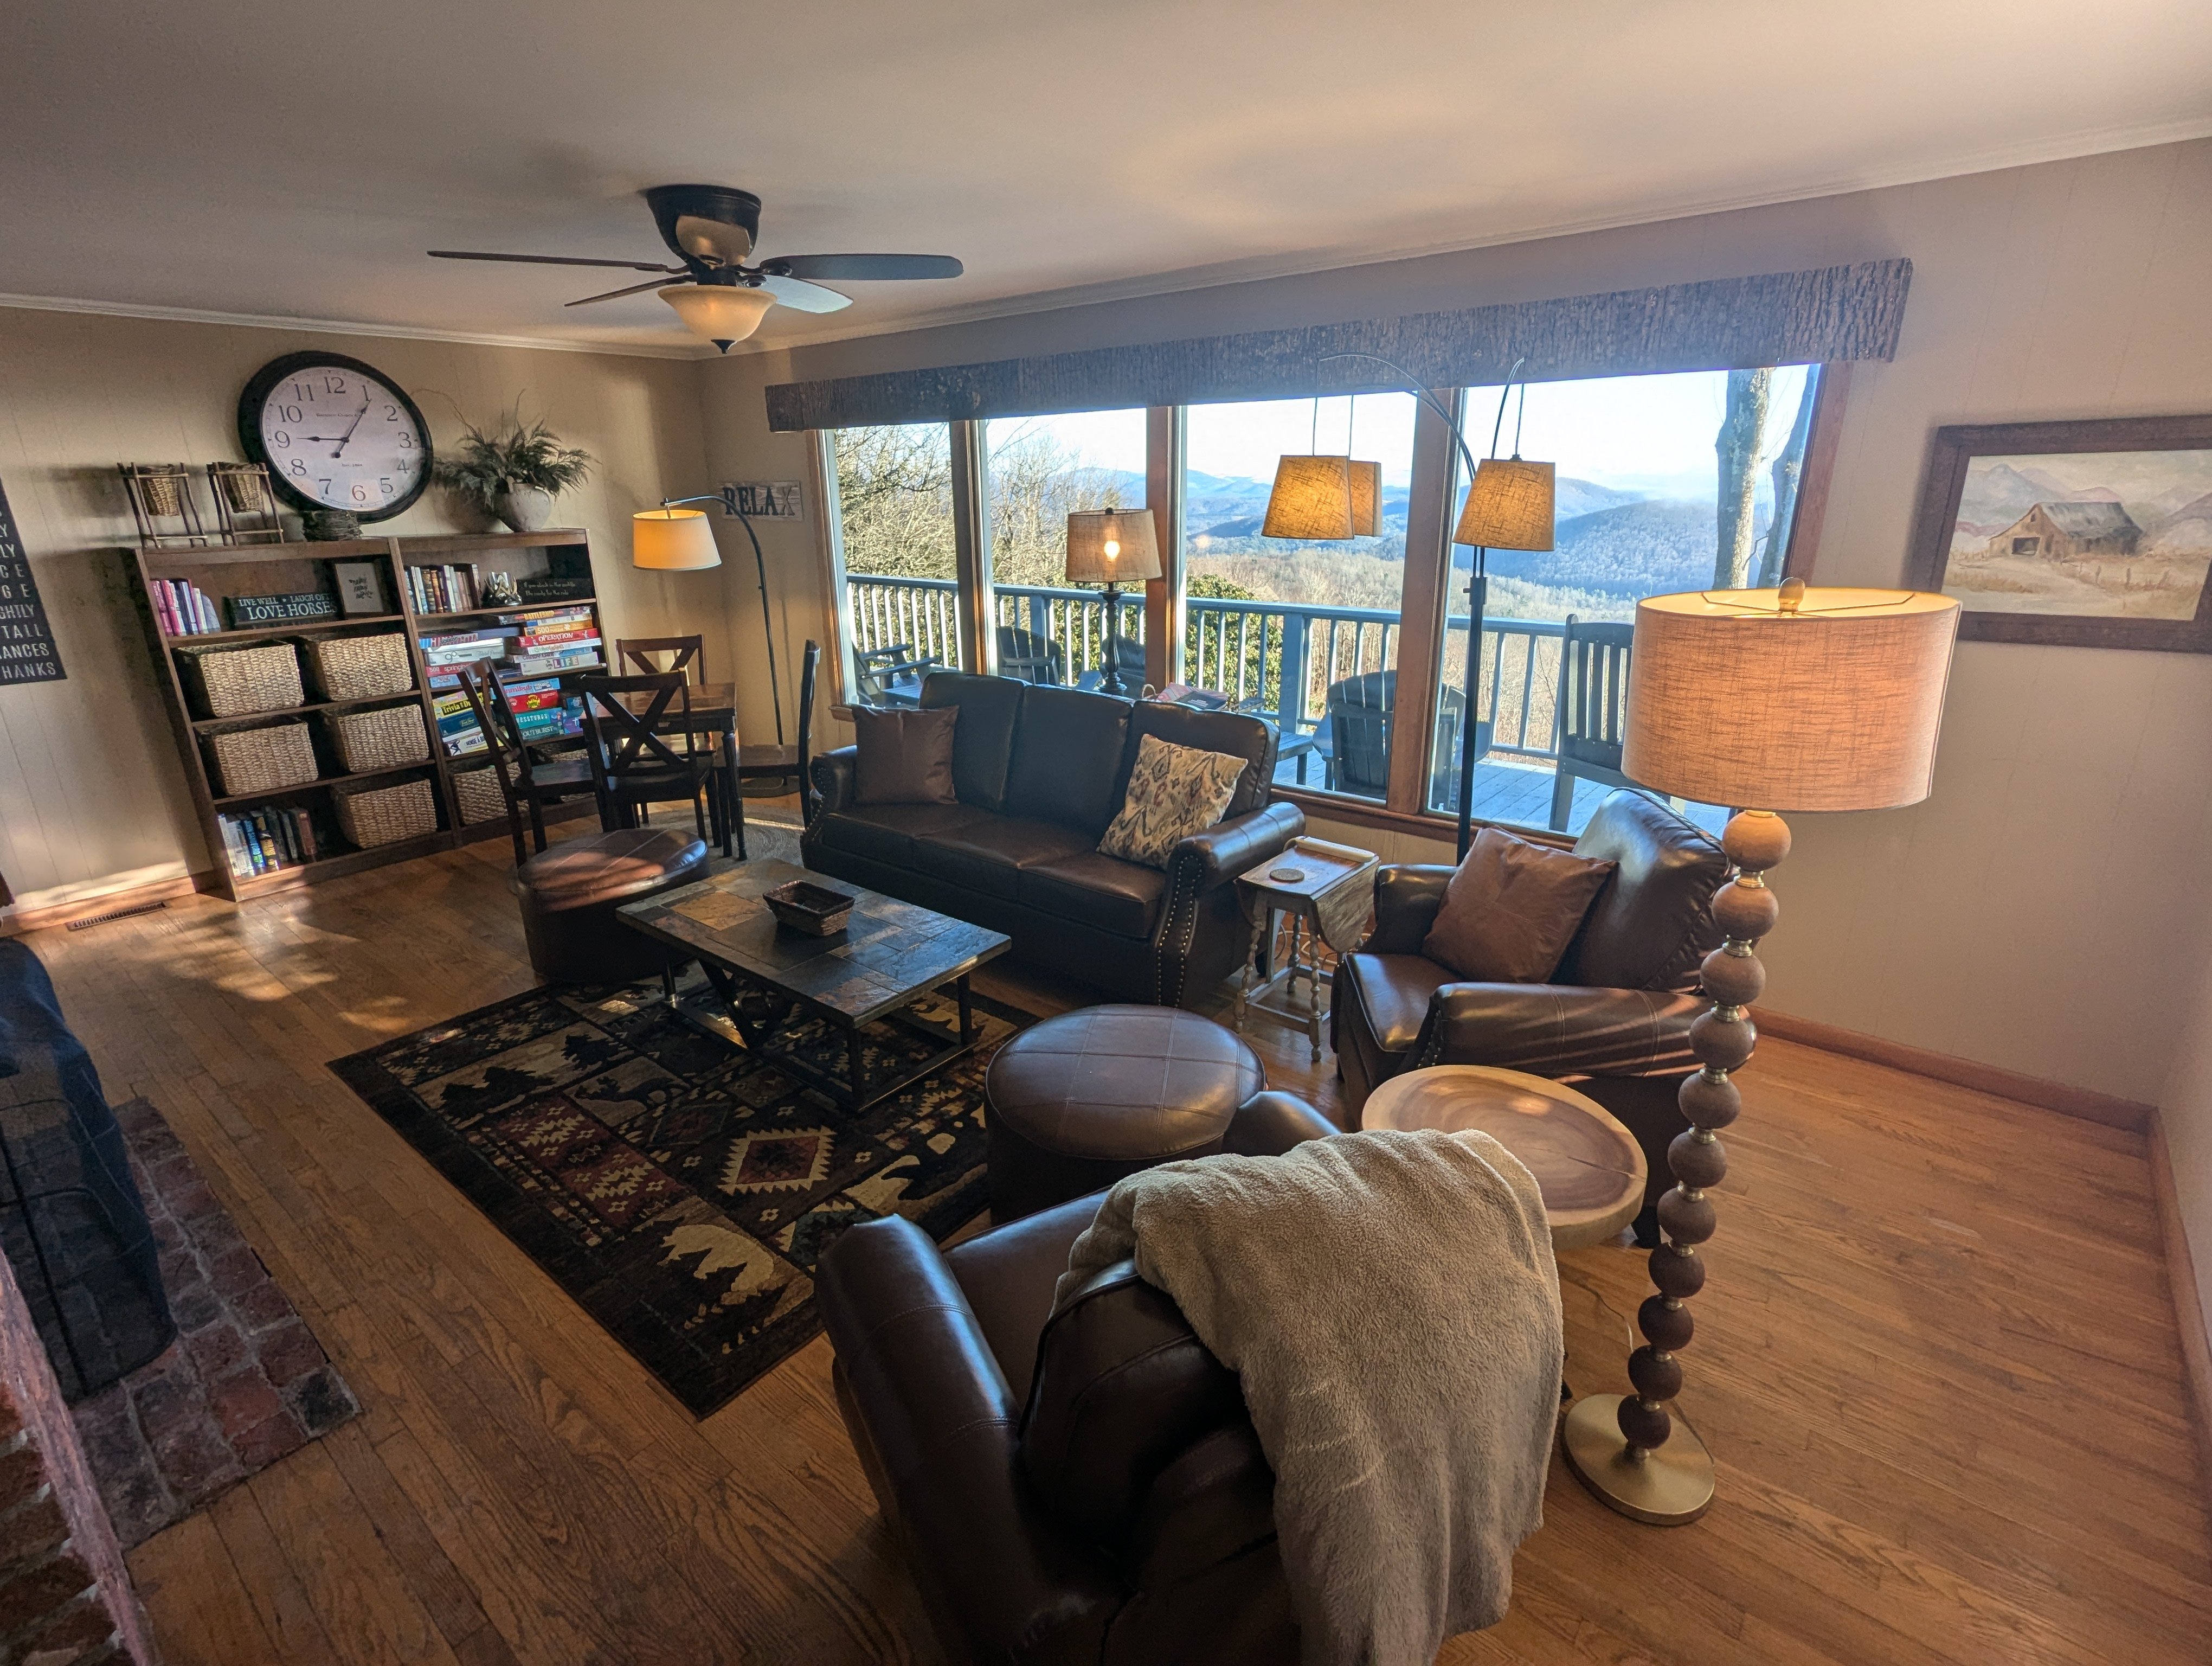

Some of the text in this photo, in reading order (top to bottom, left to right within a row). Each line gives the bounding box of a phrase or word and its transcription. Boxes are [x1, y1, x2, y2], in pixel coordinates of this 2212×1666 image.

[294, 383, 314, 401] 11
[324, 376, 346, 394] 12
[362, 385, 371, 401] 1
[279, 405, 303, 423] 10
[384, 405, 398, 421] 2
[274, 431, 291, 448] 9
[397, 431, 412, 448] 3
[291, 458, 307, 476] 8
[396, 459, 409, 474] 4
[319, 478, 332, 495] 7
[352, 484, 366, 501] 6
[380, 477, 394, 494] 5
[723, 485, 798, 516] RELAX
[239, 598, 256, 607] LIVE
[257, 597, 279, 605] WELL
[290, 594, 313, 603] LAUGH
[247, 604, 286, 620] LOVE
[1, 624, 43, 639] TALL
[538, 632, 574, 642] OPERATION
[553, 656, 579, 669] LIFE
[442, 704, 461, 714] Trivia
[522, 726, 554, 738] OUTBURST
